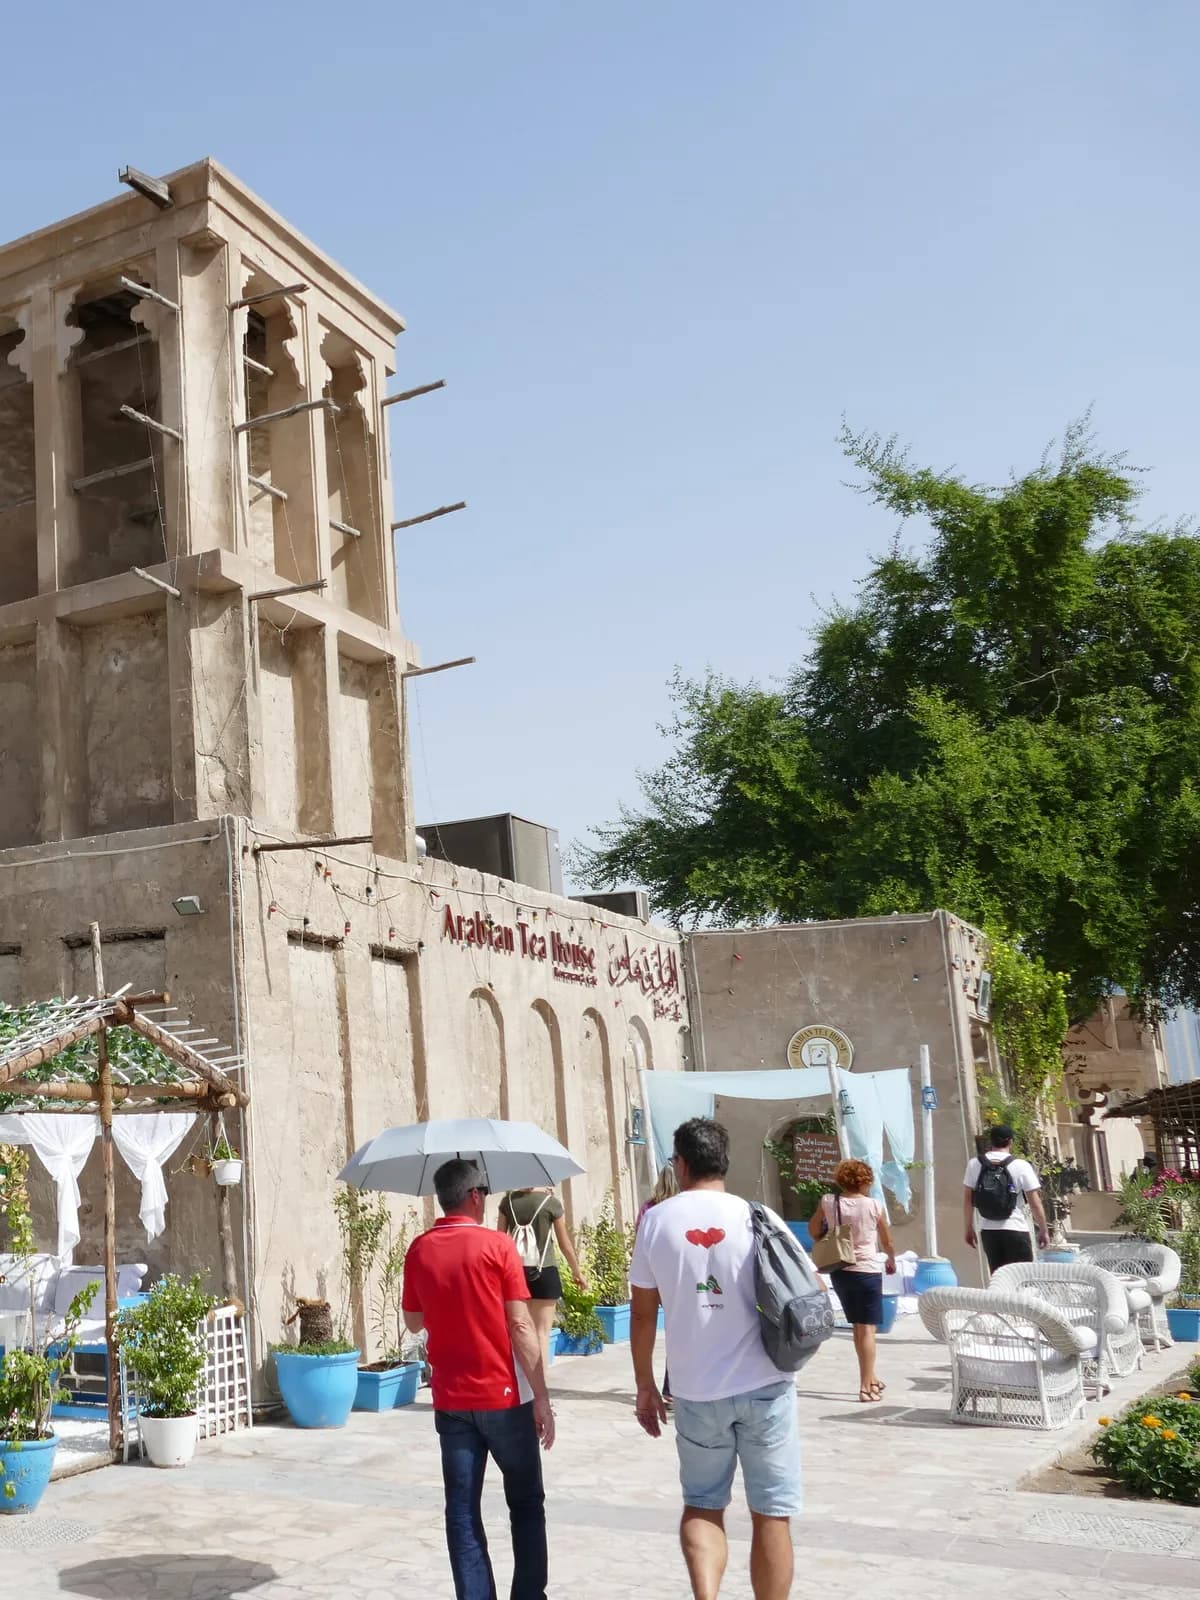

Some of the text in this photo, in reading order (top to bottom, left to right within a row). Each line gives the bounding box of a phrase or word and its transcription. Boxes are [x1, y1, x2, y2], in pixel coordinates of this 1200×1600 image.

[443, 904, 515, 951] Arabian
[517, 921, 547, 960] Tea
[551, 930, 596, 970] House
